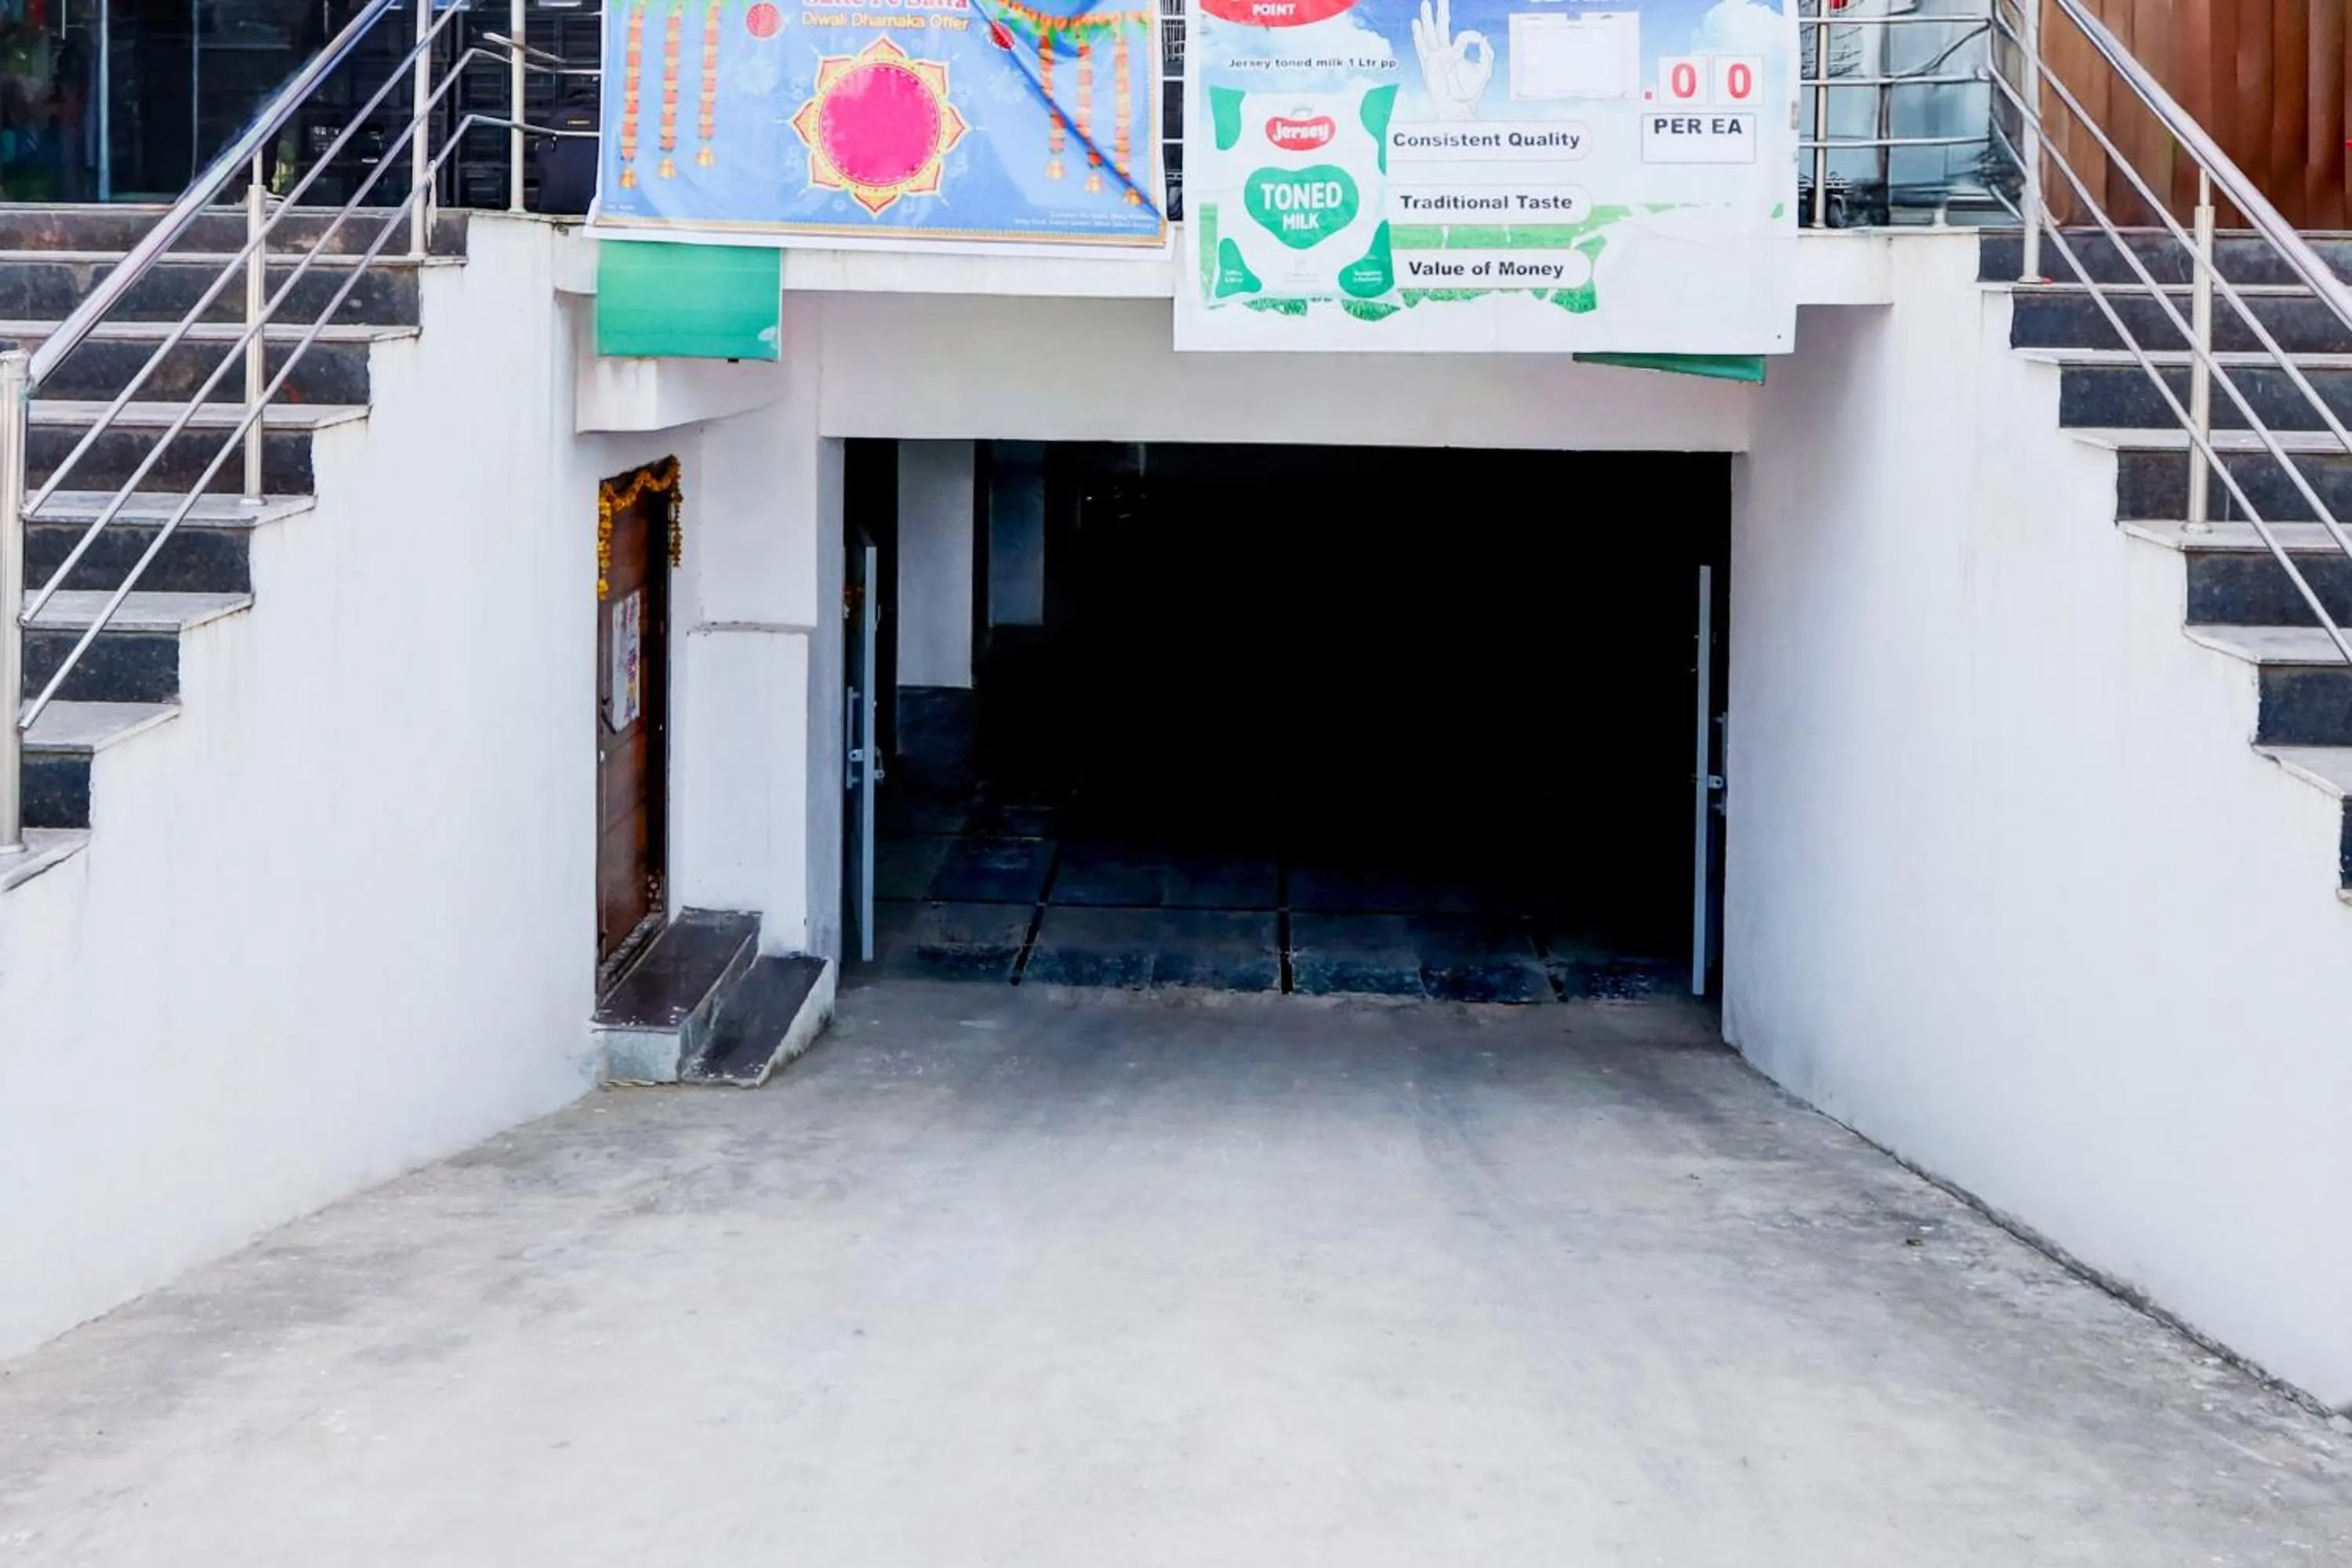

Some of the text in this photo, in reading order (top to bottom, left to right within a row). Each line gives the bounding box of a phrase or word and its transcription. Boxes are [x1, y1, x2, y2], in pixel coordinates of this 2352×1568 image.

[1252, 4, 1295, 16] POINT
[851, 13, 925, 27] Dhamaka
[931, 14, 968, 30] Offer
[1229, 57, 1397, 70] Jersey toned milk 1 Ltr pp
[1272, 121, 1330, 141] Jersey
[1654, 118, 1742, 134] PER EA
[1393, 132, 1580, 150] Consistent Quality
[1261, 182, 1343, 210] TONED
[1400, 195, 1573, 209] Traditional Taste
[1283, 212, 1319, 230] MILK
[1409, 261, 1564, 279] Value of Money
